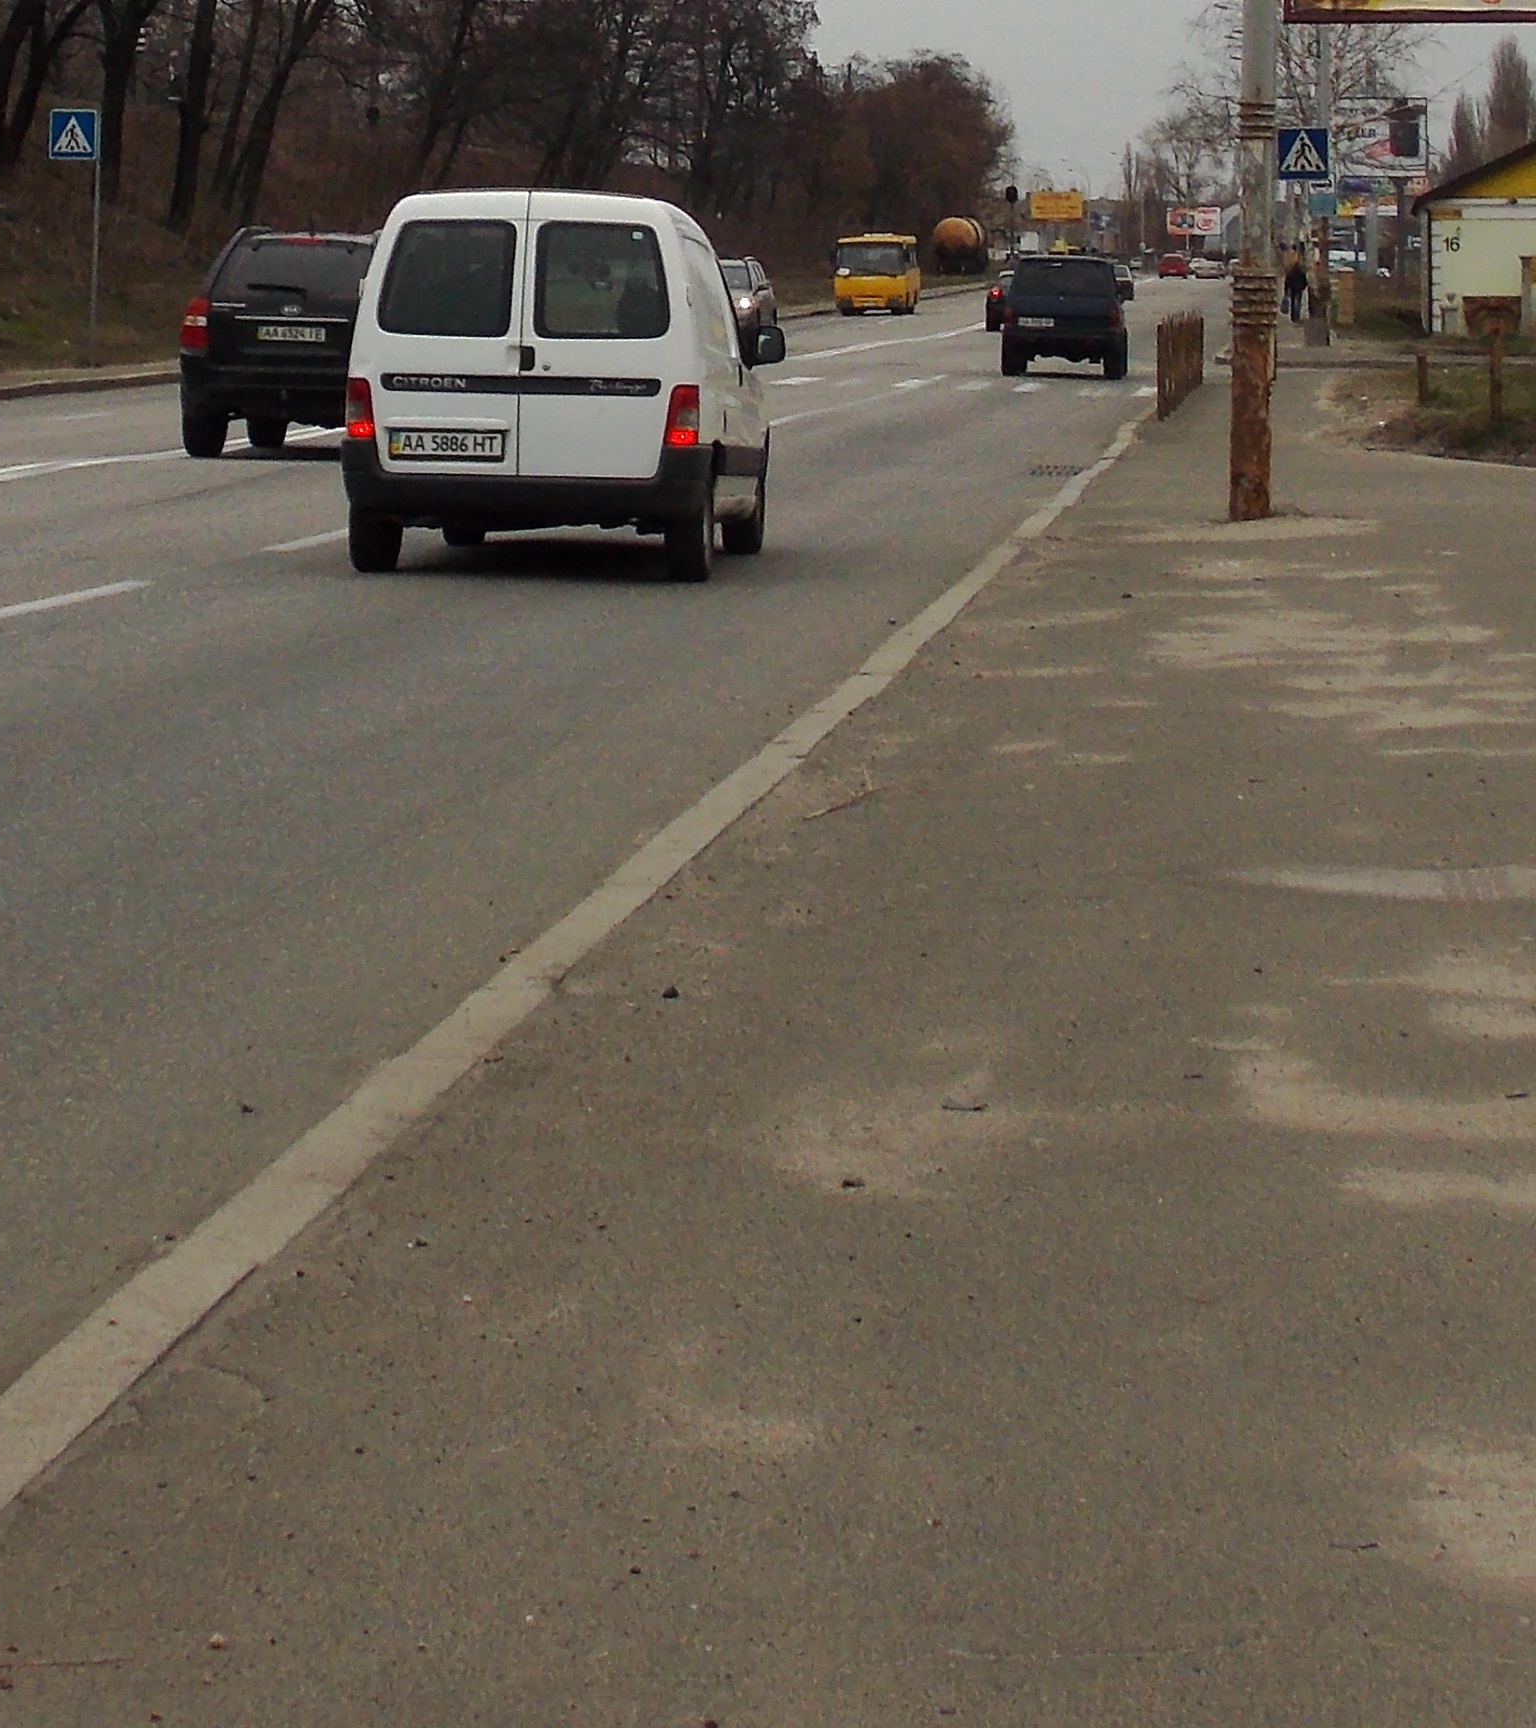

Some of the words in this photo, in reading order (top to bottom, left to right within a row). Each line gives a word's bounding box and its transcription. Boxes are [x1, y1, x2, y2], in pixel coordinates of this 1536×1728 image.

[1443, 236, 1461, 252] 16
[401, 435, 426, 452] AA
[431, 435, 468, 452] 5886
[473, 435, 498, 453] HT
